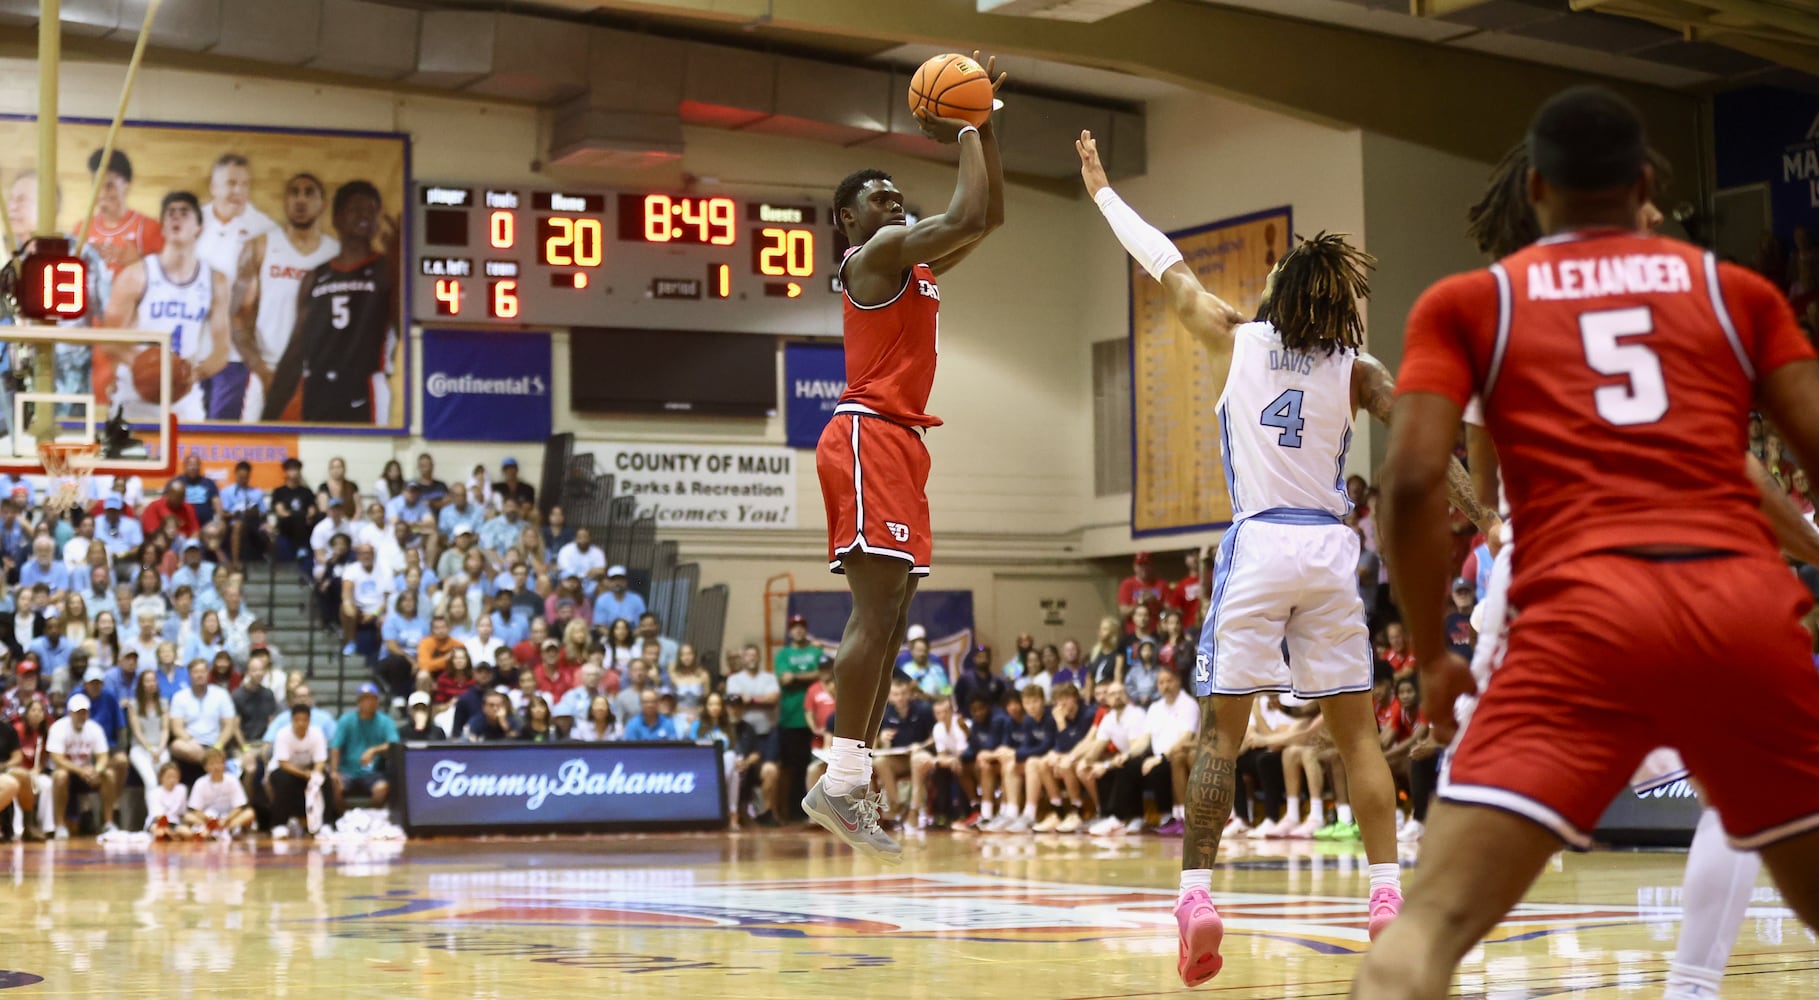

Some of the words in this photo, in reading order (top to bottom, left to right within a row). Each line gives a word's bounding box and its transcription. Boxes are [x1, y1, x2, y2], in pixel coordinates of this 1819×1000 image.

[491, 211, 514, 248] 0
[644, 194, 736, 245] 8:49
[546, 217, 602, 266] 20
[761, 228, 814, 277] 20
[43, 262, 84, 313] 13
[718, 263, 730, 297] 1
[1527, 255, 1691, 300] ALEXANDER
[332, 296, 351, 330] 5
[435, 279, 460, 314] 4
[495, 279, 519, 318] 6
[1269, 350, 1315, 376] DAVIS
[1579, 305, 1670, 426] 5
[427, 372, 530, 397] Continental
[795, 380, 847, 399] HAW
[1260, 388, 1305, 449] 4
[616, 452, 701, 473] COUNTY
[706, 454, 733, 473] OF
[738, 456, 790, 475] MAUI
[621, 480, 670, 495] Parks
[675, 481, 686, 495] &
[691, 481, 785, 497] Recreation
[738, 504, 790, 523] You!
[426, 760, 549, 810] Tommy
[549, 758, 696, 797] Bahama
[1199, 785, 1230, 804] YOU
